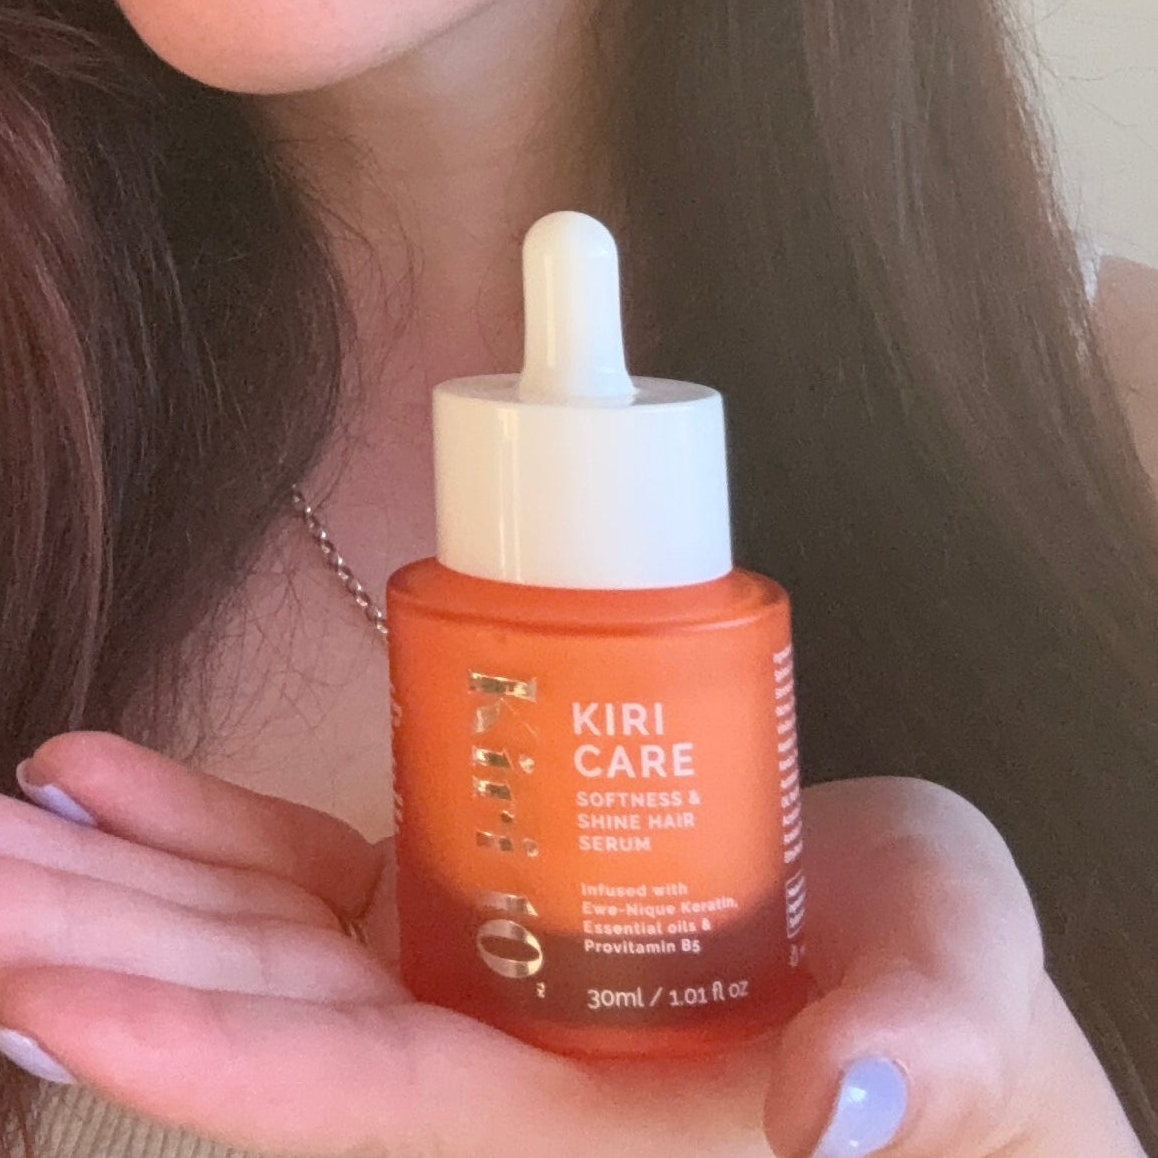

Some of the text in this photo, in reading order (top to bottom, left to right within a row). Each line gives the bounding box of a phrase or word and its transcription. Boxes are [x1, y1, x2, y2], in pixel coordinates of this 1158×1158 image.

[572, 702, 664, 736] KIRI
[574, 743, 695, 778] CARE
[576, 789, 702, 808] SOFTNESS &
[577, 811, 695, 830] SHINE HAIR
[578, 835, 652, 852] SERUM
[581, 881, 688, 897] Infused with
[582, 901, 676, 918] Ewe-Nique
[583, 917, 711, 935] Essential oils &
[584, 938, 701, 954] Provitamin B5
[587, 986, 644, 1010] 30ml
[669, 987, 708, 1007] 1.01
[712, 980, 725, 1002] fl
[729, 980, 749, 998] oz
